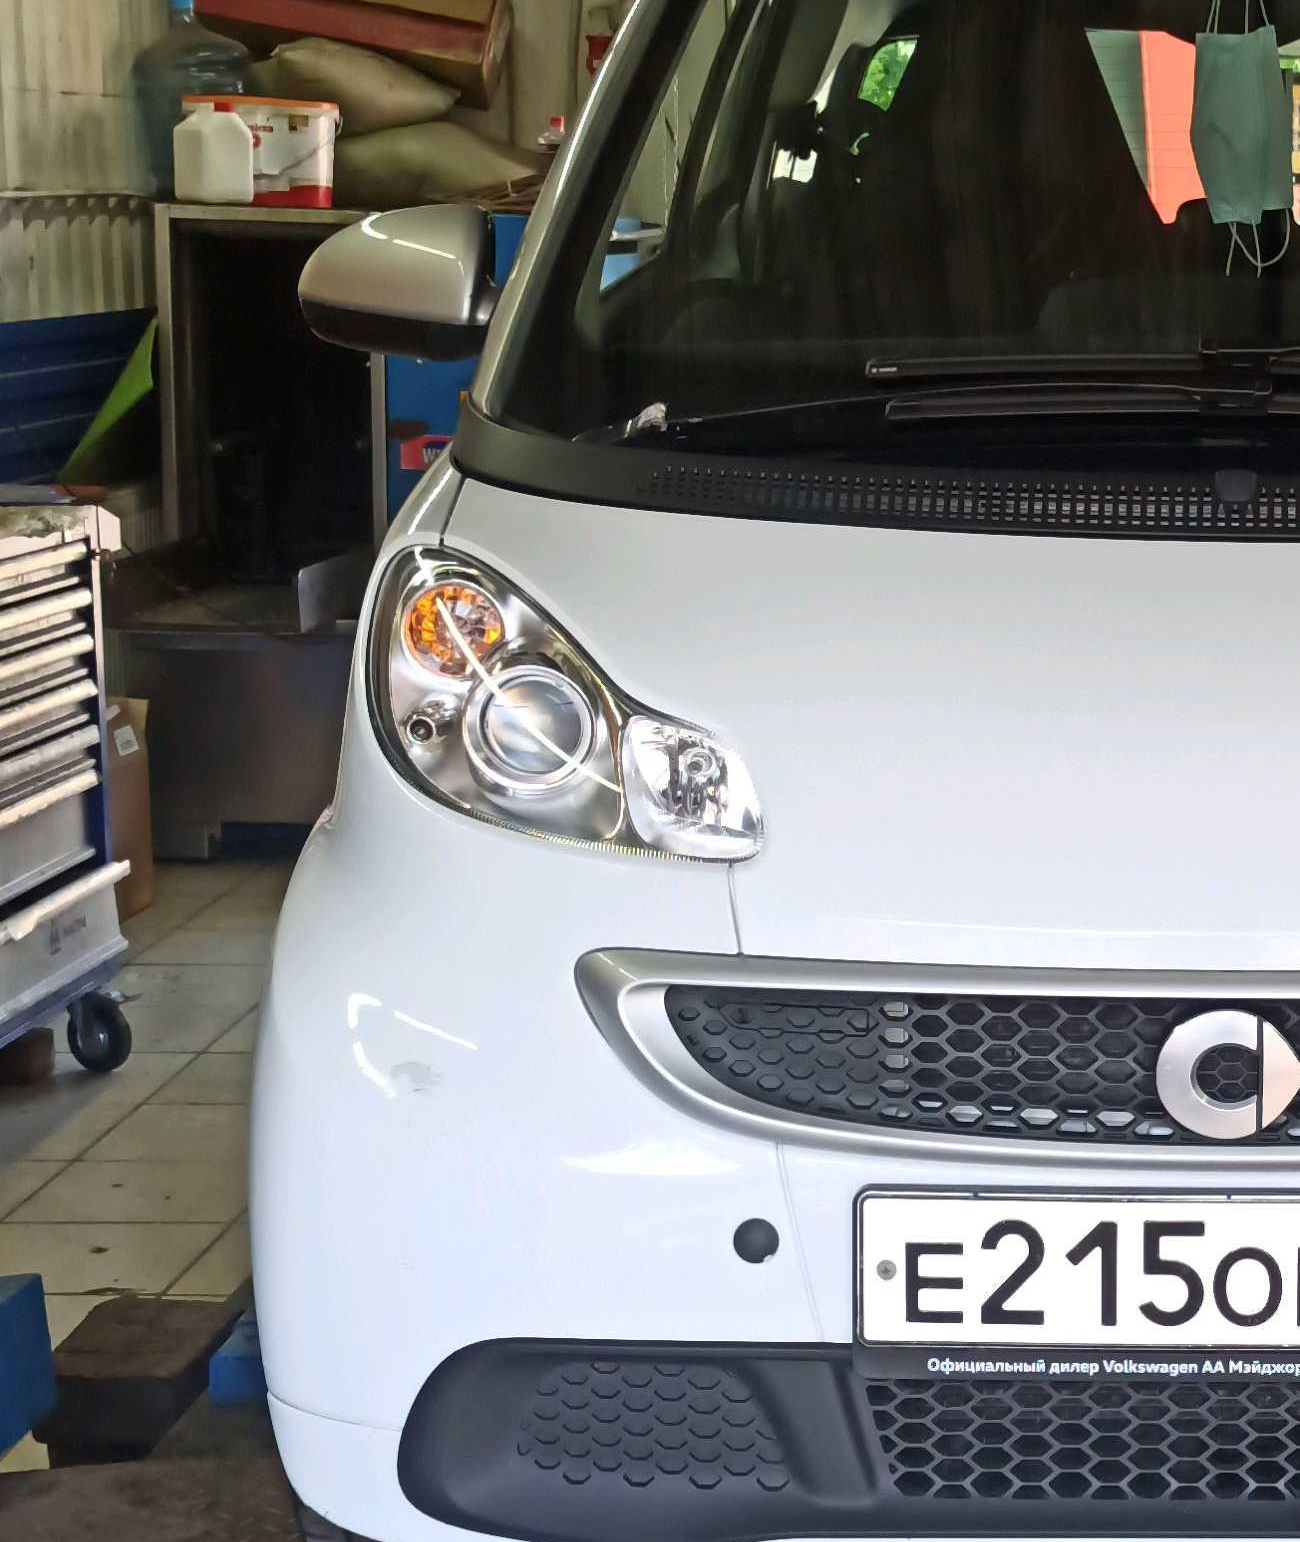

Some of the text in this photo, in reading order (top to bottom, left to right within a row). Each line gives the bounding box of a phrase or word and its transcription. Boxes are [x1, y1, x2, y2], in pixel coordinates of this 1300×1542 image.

[926, 1357, 1046, 1376] Официальный
[1049, 1359, 1100, 1376] дилер
[1102, 1359, 1199, 1377] Volkswagen
